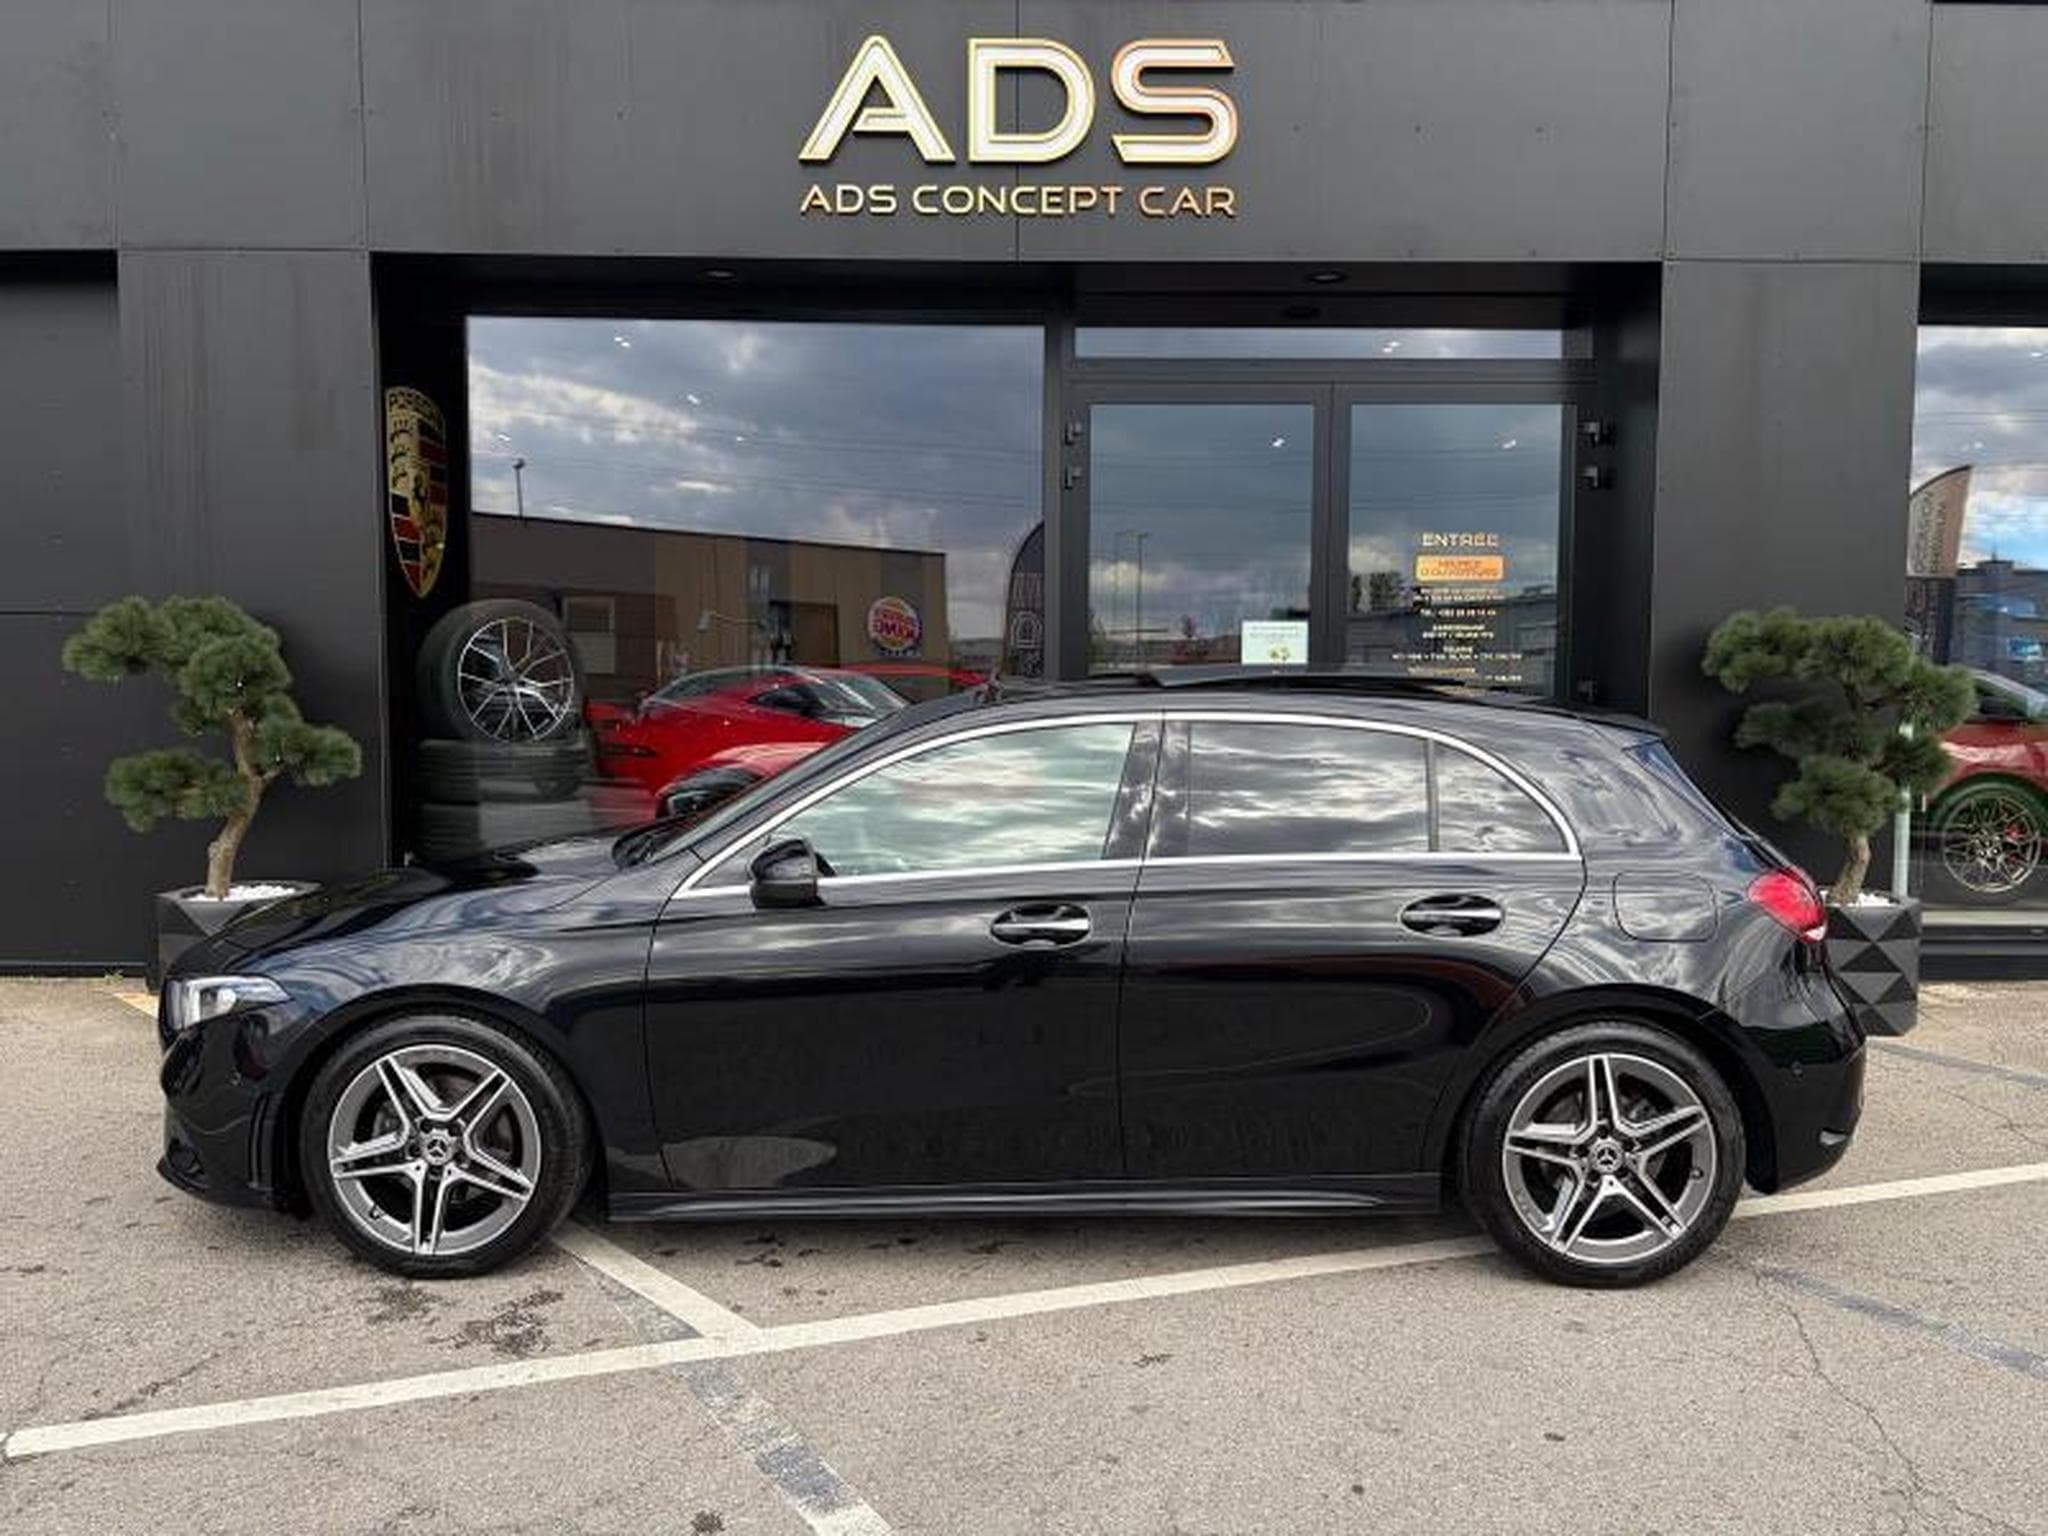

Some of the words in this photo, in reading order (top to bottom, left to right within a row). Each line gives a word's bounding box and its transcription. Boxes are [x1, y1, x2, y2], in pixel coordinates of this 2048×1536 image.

[798, 34, 1238, 163] ADS
[800, 185, 897, 215] ADS
[912, 184, 1123, 216] CONCEPT
[1138, 186, 1236, 217] CAR
